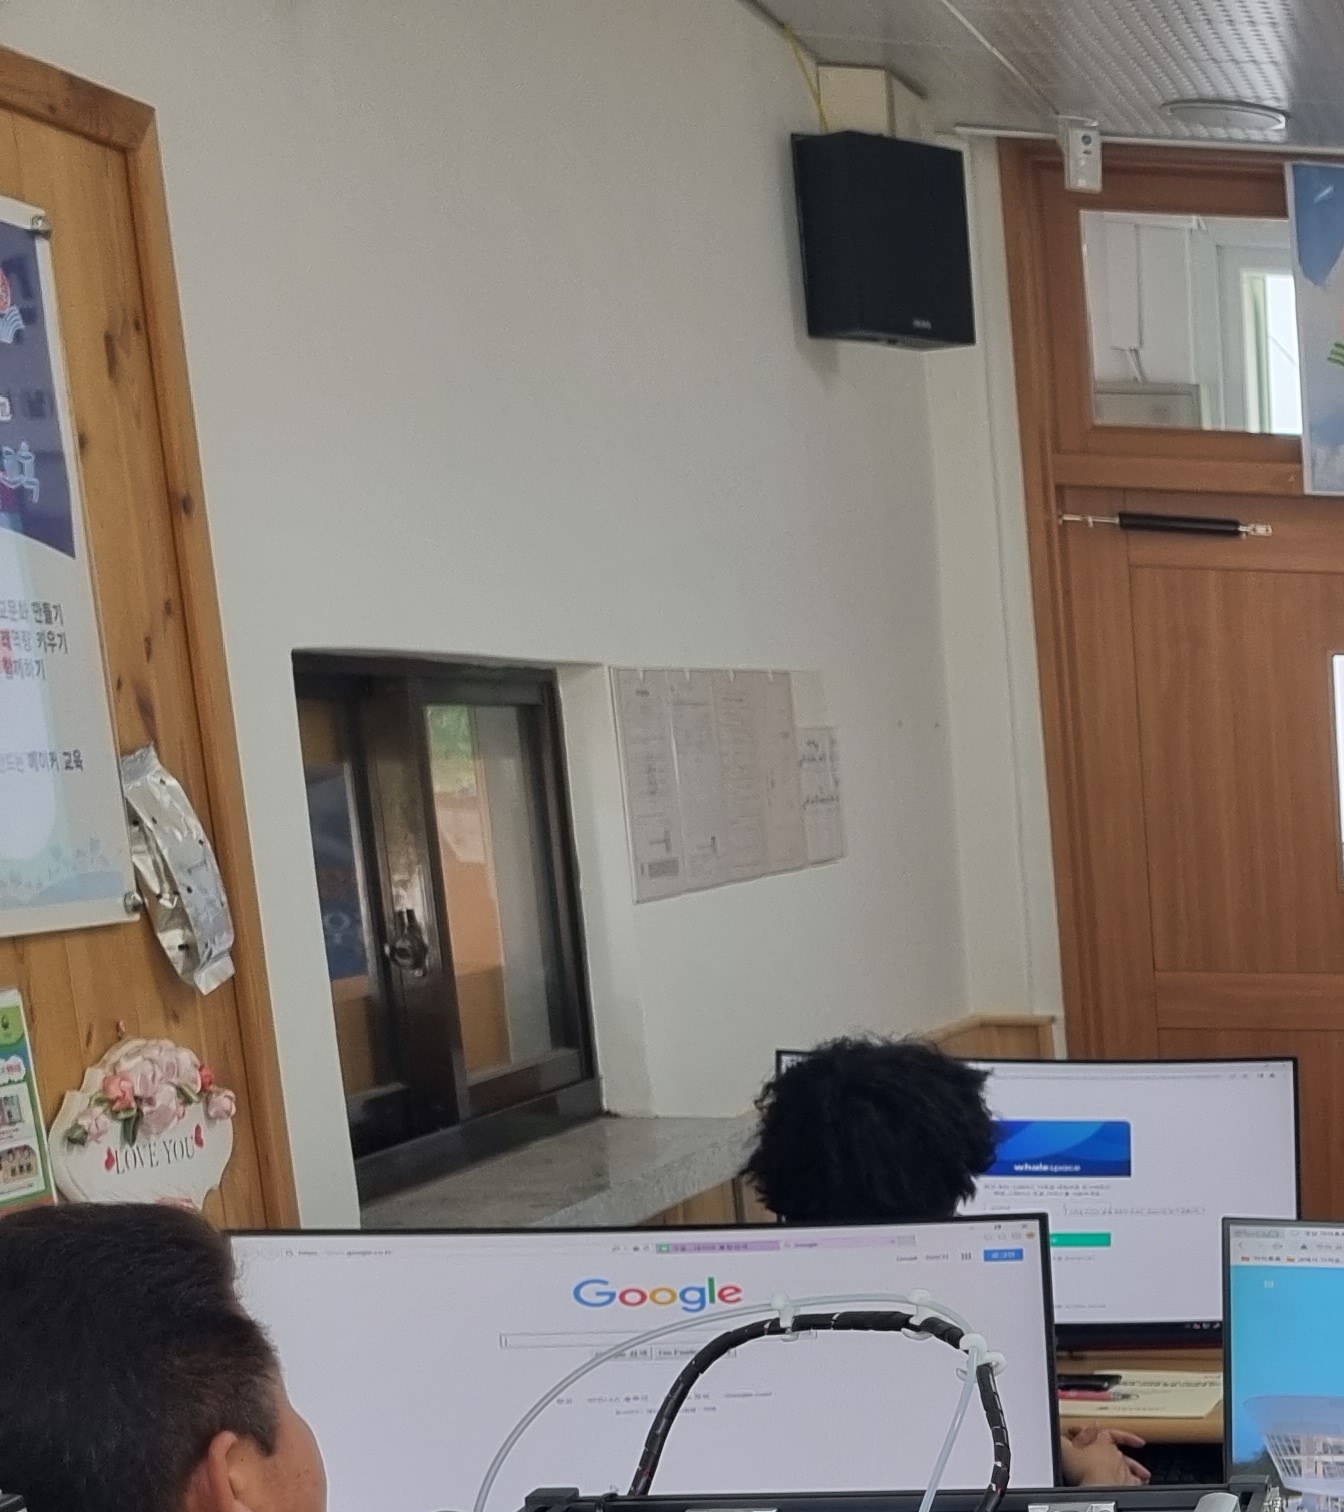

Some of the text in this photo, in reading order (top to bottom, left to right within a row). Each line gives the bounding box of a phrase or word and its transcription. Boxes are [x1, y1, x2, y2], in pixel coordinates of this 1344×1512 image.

[63, 749, 83, 771] 교육
[115, 1136, 195, 1175] LOVE YOU
[573, 1277, 742, 1313] Google
